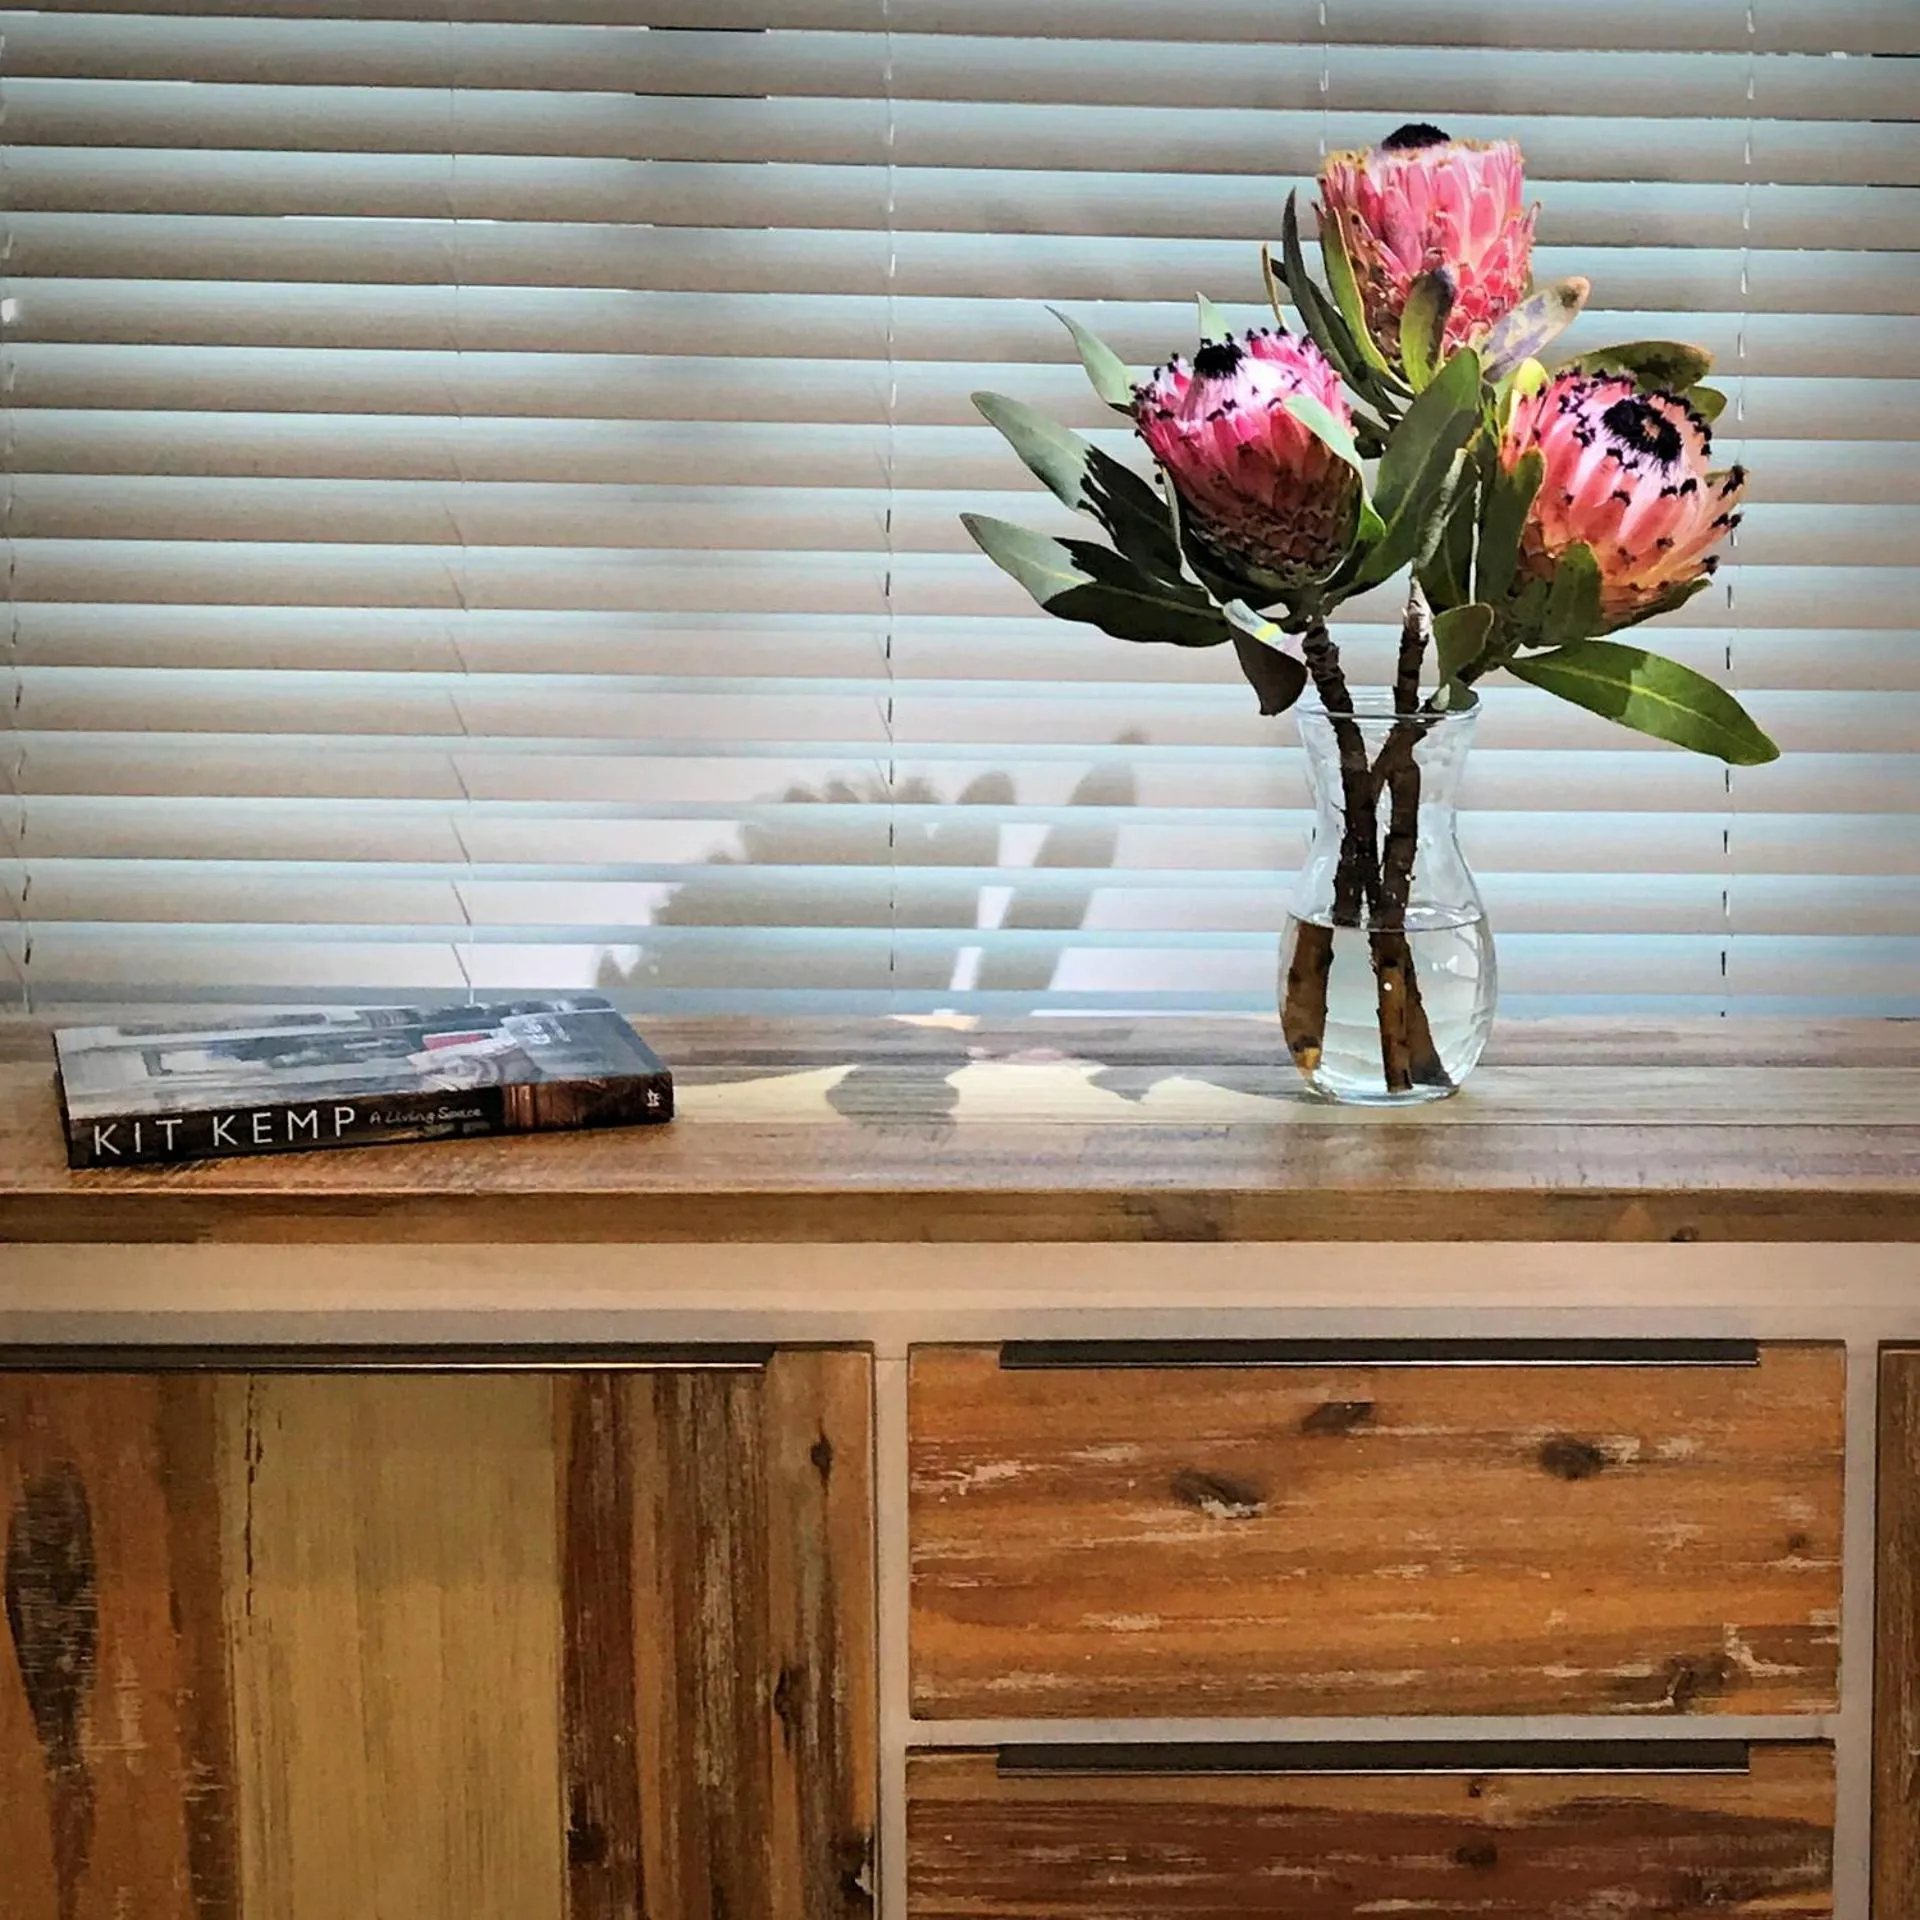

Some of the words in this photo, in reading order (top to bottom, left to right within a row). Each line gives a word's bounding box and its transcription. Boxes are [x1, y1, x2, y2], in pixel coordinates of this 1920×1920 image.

[94, 1118, 183, 1156] KIT
[212, 1106, 355, 1147] KEMP
[369, 1111, 381, 1125] A
[385, 1110, 436, 1124] Living
